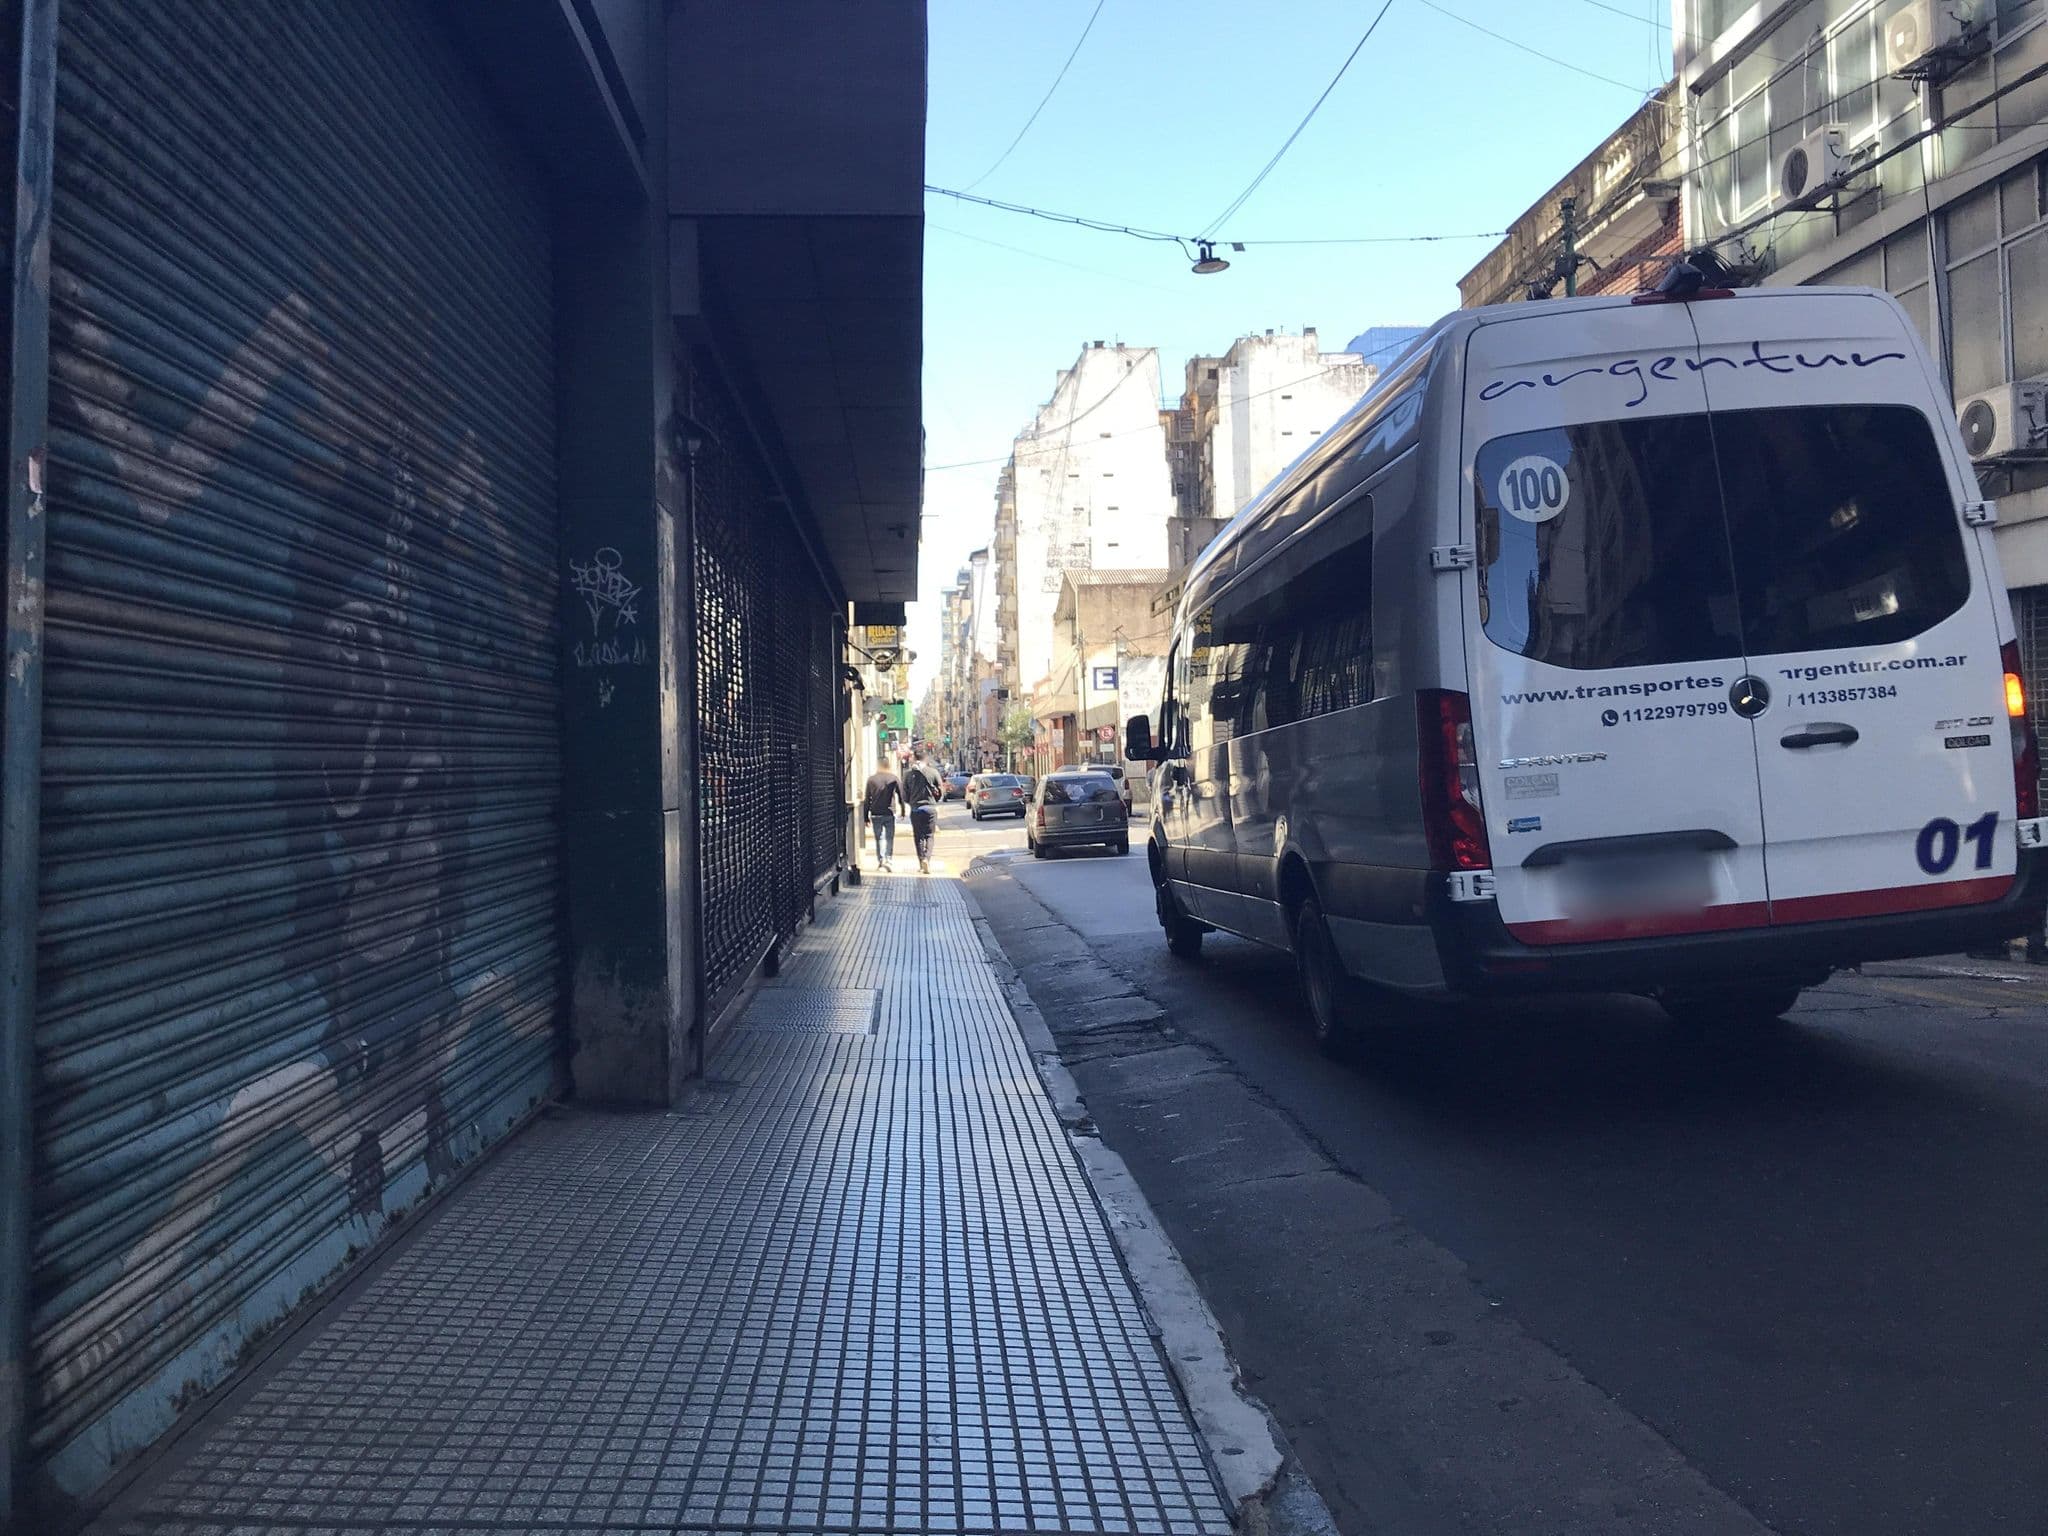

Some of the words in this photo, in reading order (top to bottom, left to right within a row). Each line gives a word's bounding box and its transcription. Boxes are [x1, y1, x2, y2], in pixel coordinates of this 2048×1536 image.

[1479, 341, 1905, 407] argentur
[1506, 466, 1561, 511] 100
[1096, 669, 1114, 687] E
[1501, 676, 1724, 705] www.transportes
[1622, 702, 1728, 723] 1122979799
[1797, 685, 1898, 706] 1133857384
[1498, 751, 1608, 770] SPRINTER
[1915, 811, 2000, 876] 01
